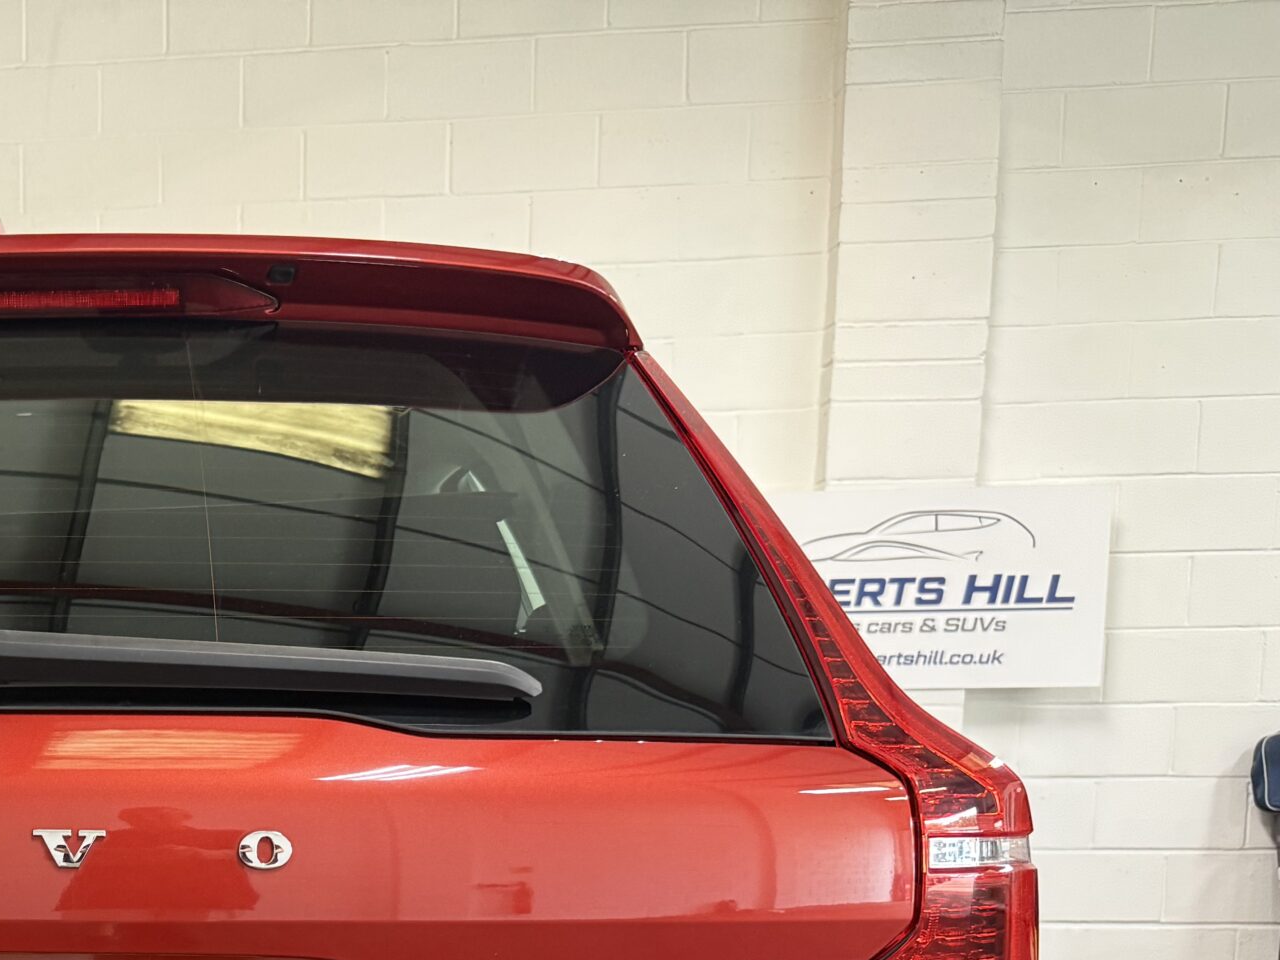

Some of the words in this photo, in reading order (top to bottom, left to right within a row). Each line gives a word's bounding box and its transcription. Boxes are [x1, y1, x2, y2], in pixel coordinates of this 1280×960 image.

[962, 574, 1075, 605] HILL
[866, 620, 914, 634] cars
[919, 617, 936, 633] &
[943, 616, 1007, 633] SUVs
